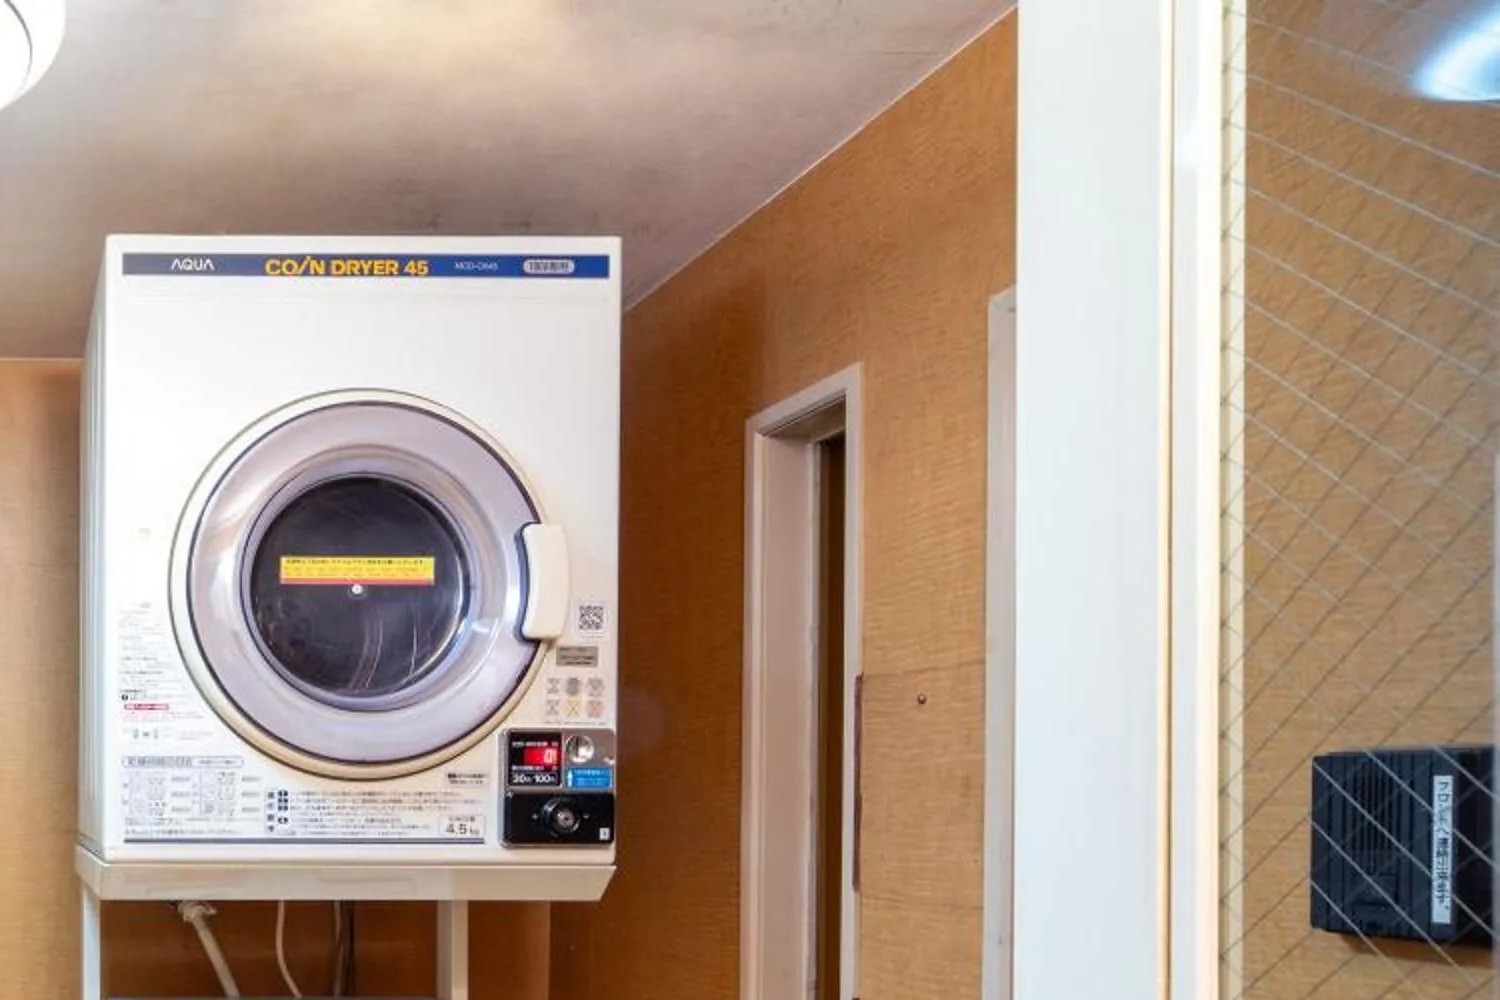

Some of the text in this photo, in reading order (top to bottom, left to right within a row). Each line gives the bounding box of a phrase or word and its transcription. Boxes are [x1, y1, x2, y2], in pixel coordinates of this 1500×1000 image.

[171, 258, 215, 271] AQUA
[330, 260, 399, 276] DRYER
[404, 260, 429, 276] 45
